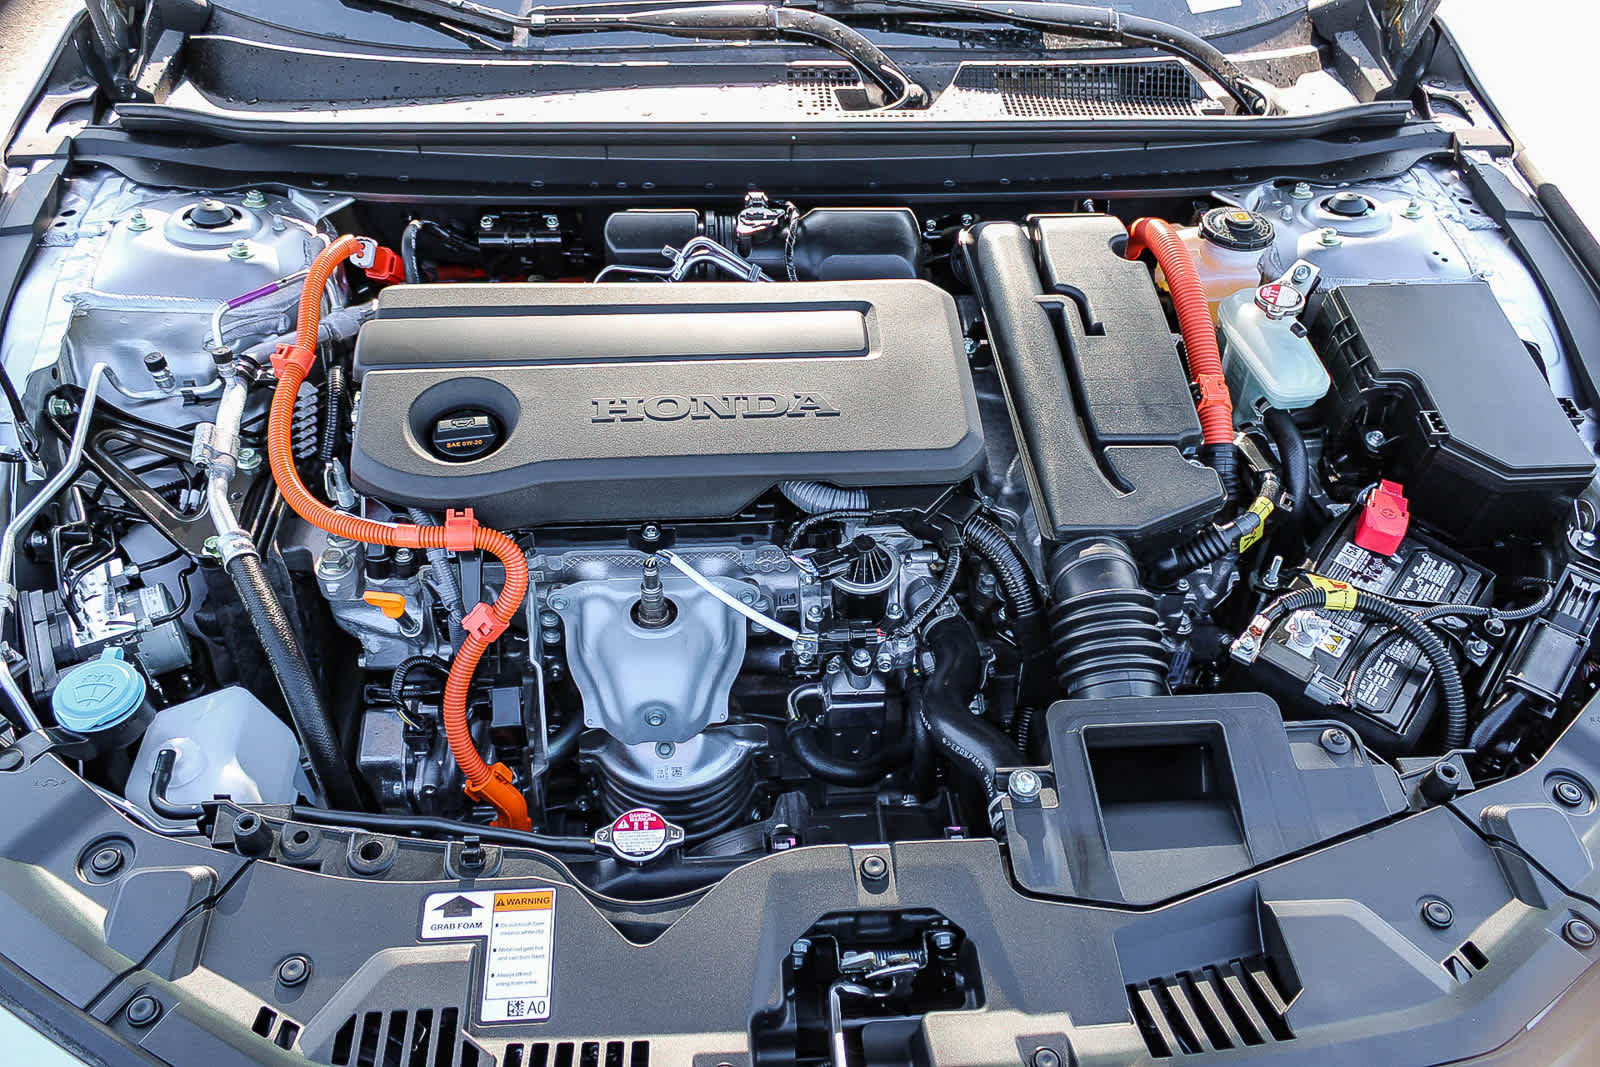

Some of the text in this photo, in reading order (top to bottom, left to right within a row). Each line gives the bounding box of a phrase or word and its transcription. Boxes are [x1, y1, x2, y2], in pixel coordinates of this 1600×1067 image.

[591, 391, 841, 423] HONDA
[506, 896, 550, 906] WARNING
[430, 921, 483, 931] GRAB FOAM
[527, 1000, 546, 1015] A0
